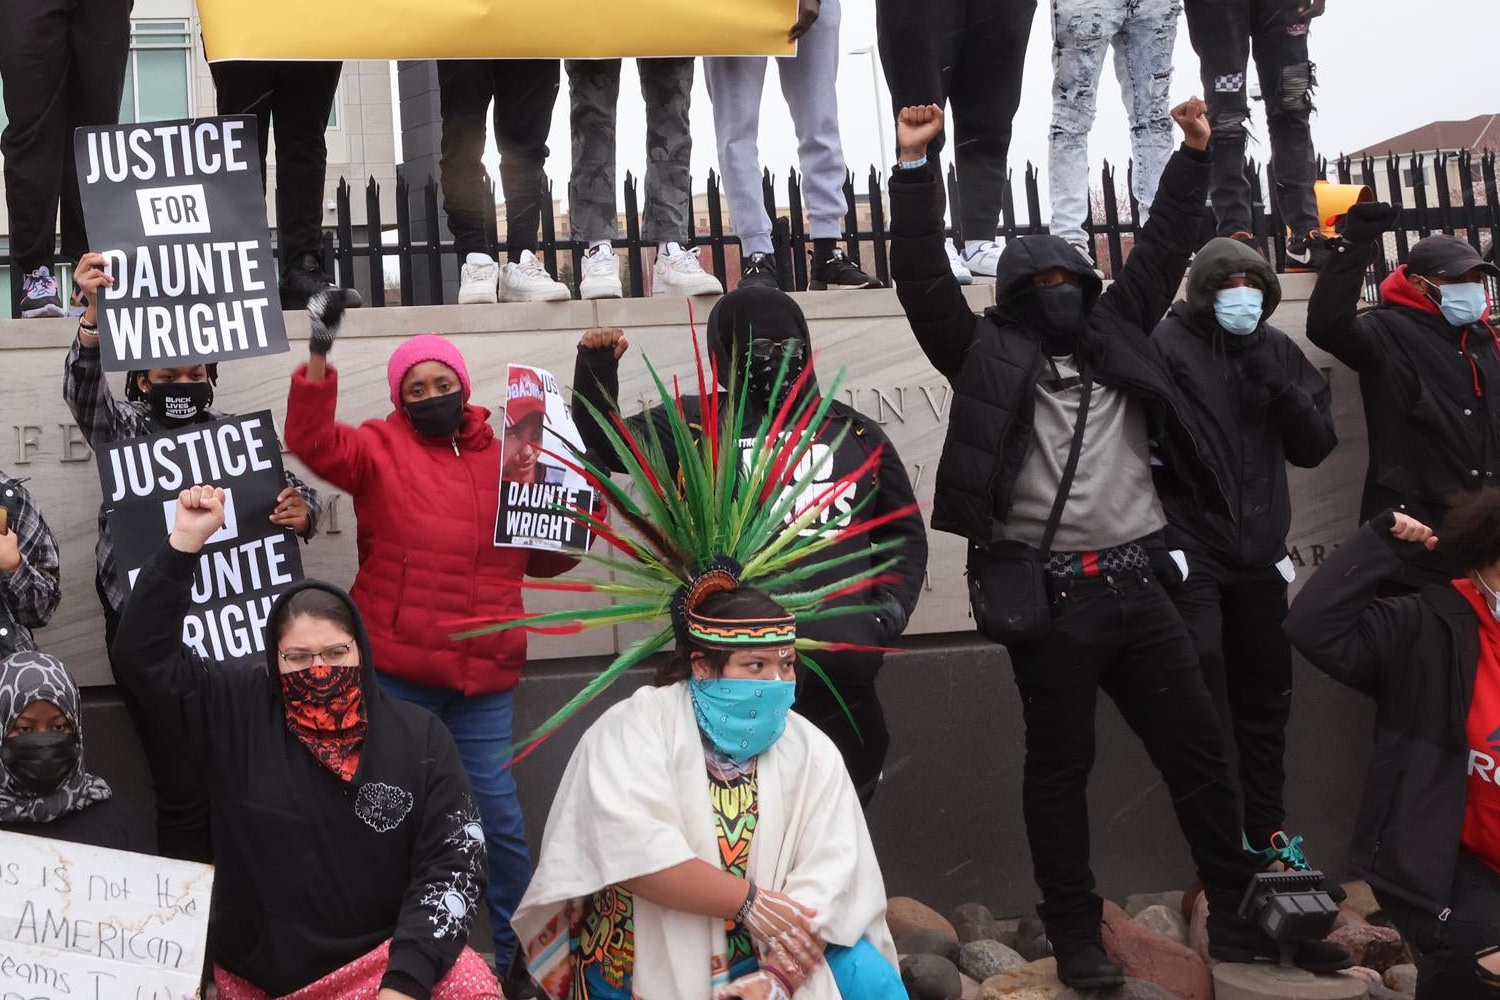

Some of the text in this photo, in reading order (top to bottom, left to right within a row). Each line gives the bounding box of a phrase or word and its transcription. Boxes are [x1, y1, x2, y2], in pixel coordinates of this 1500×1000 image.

[86, 121, 248, 184] JUSTICE
[148, 191, 201, 226] FOR
[103, 240, 266, 300] DAUNTE
[106, 298, 269, 361] WRIGHT
[108, 418, 273, 502] JUSTICE
[507, 481, 580, 511] DAUNTE
[506, 511, 576, 542] WRIGHT
[128, 544, 293, 604] UNTE
[182, 594, 281, 662] RIGH
